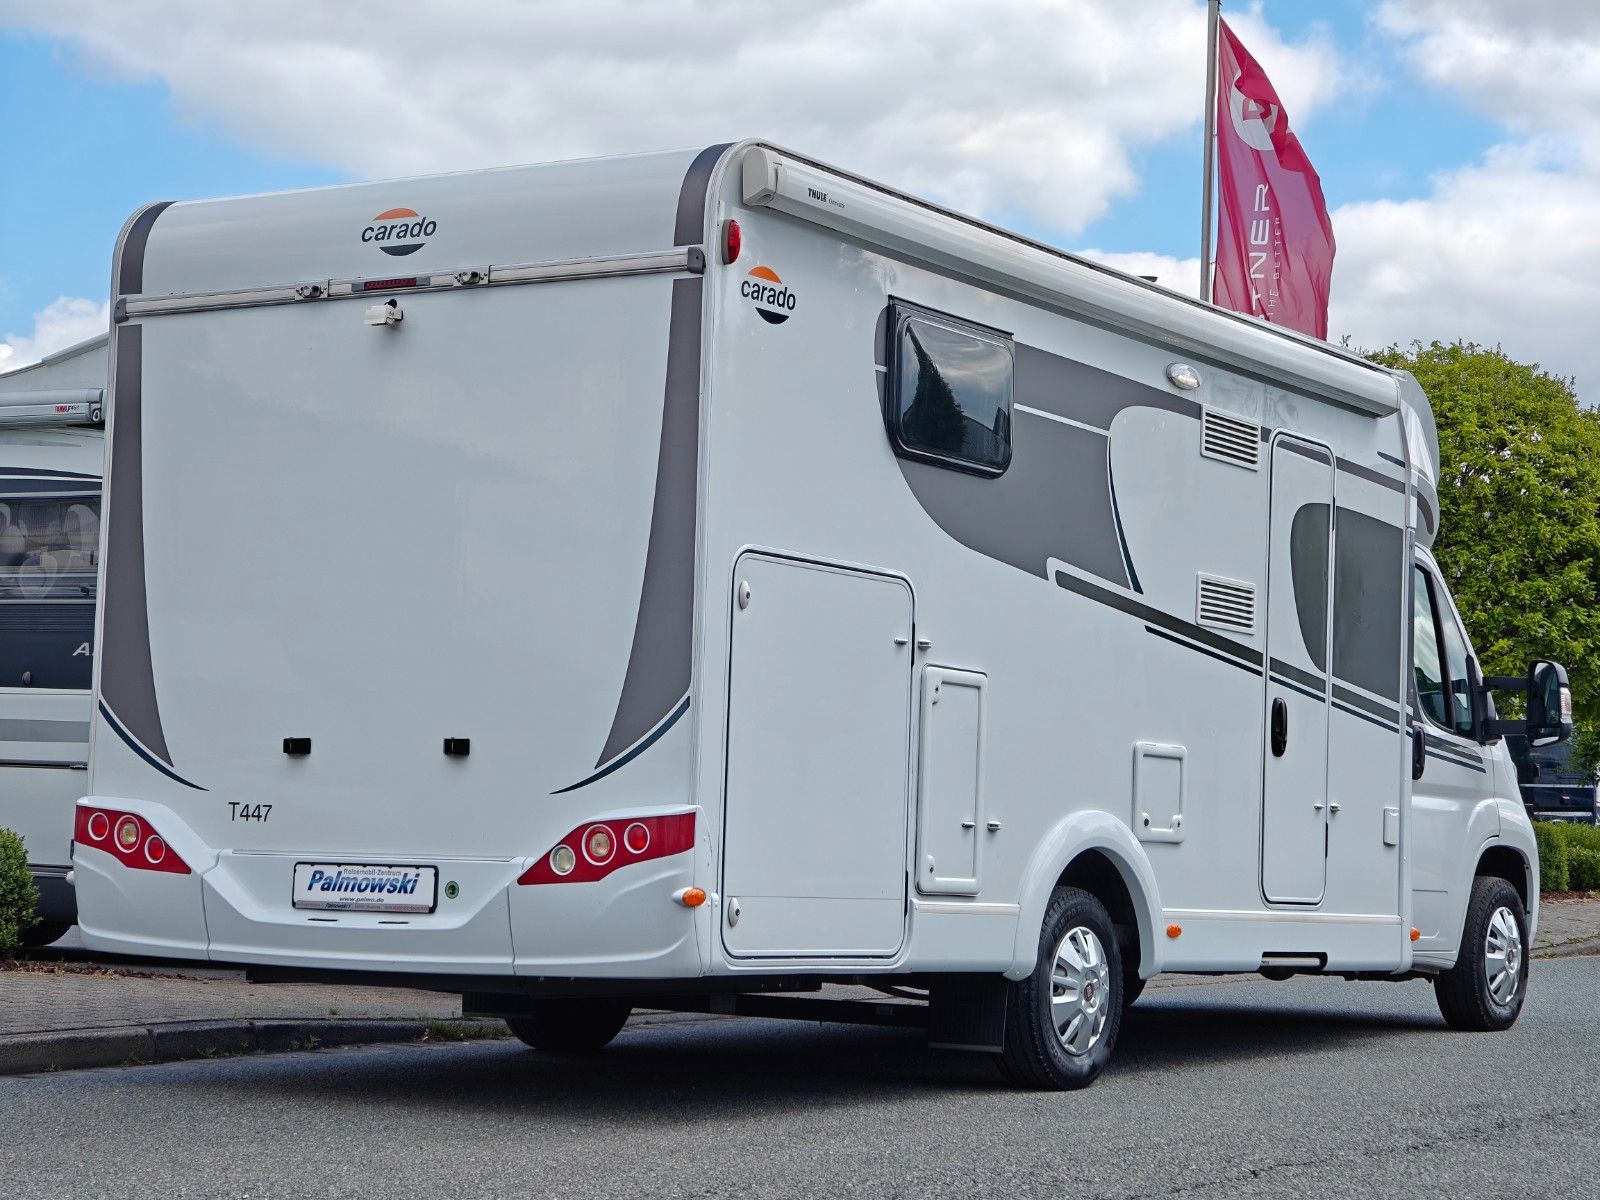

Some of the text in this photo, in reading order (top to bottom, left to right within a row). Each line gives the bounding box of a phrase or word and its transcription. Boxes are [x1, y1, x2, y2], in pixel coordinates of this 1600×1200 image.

[807, 187, 827, 203] THULE
[361, 216, 437, 243] carado
[1249, 184, 1270, 319] TNER
[741, 280, 796, 311] carado
[228, 801, 273, 822] T447
[308, 870, 419, 894] Palmowski
